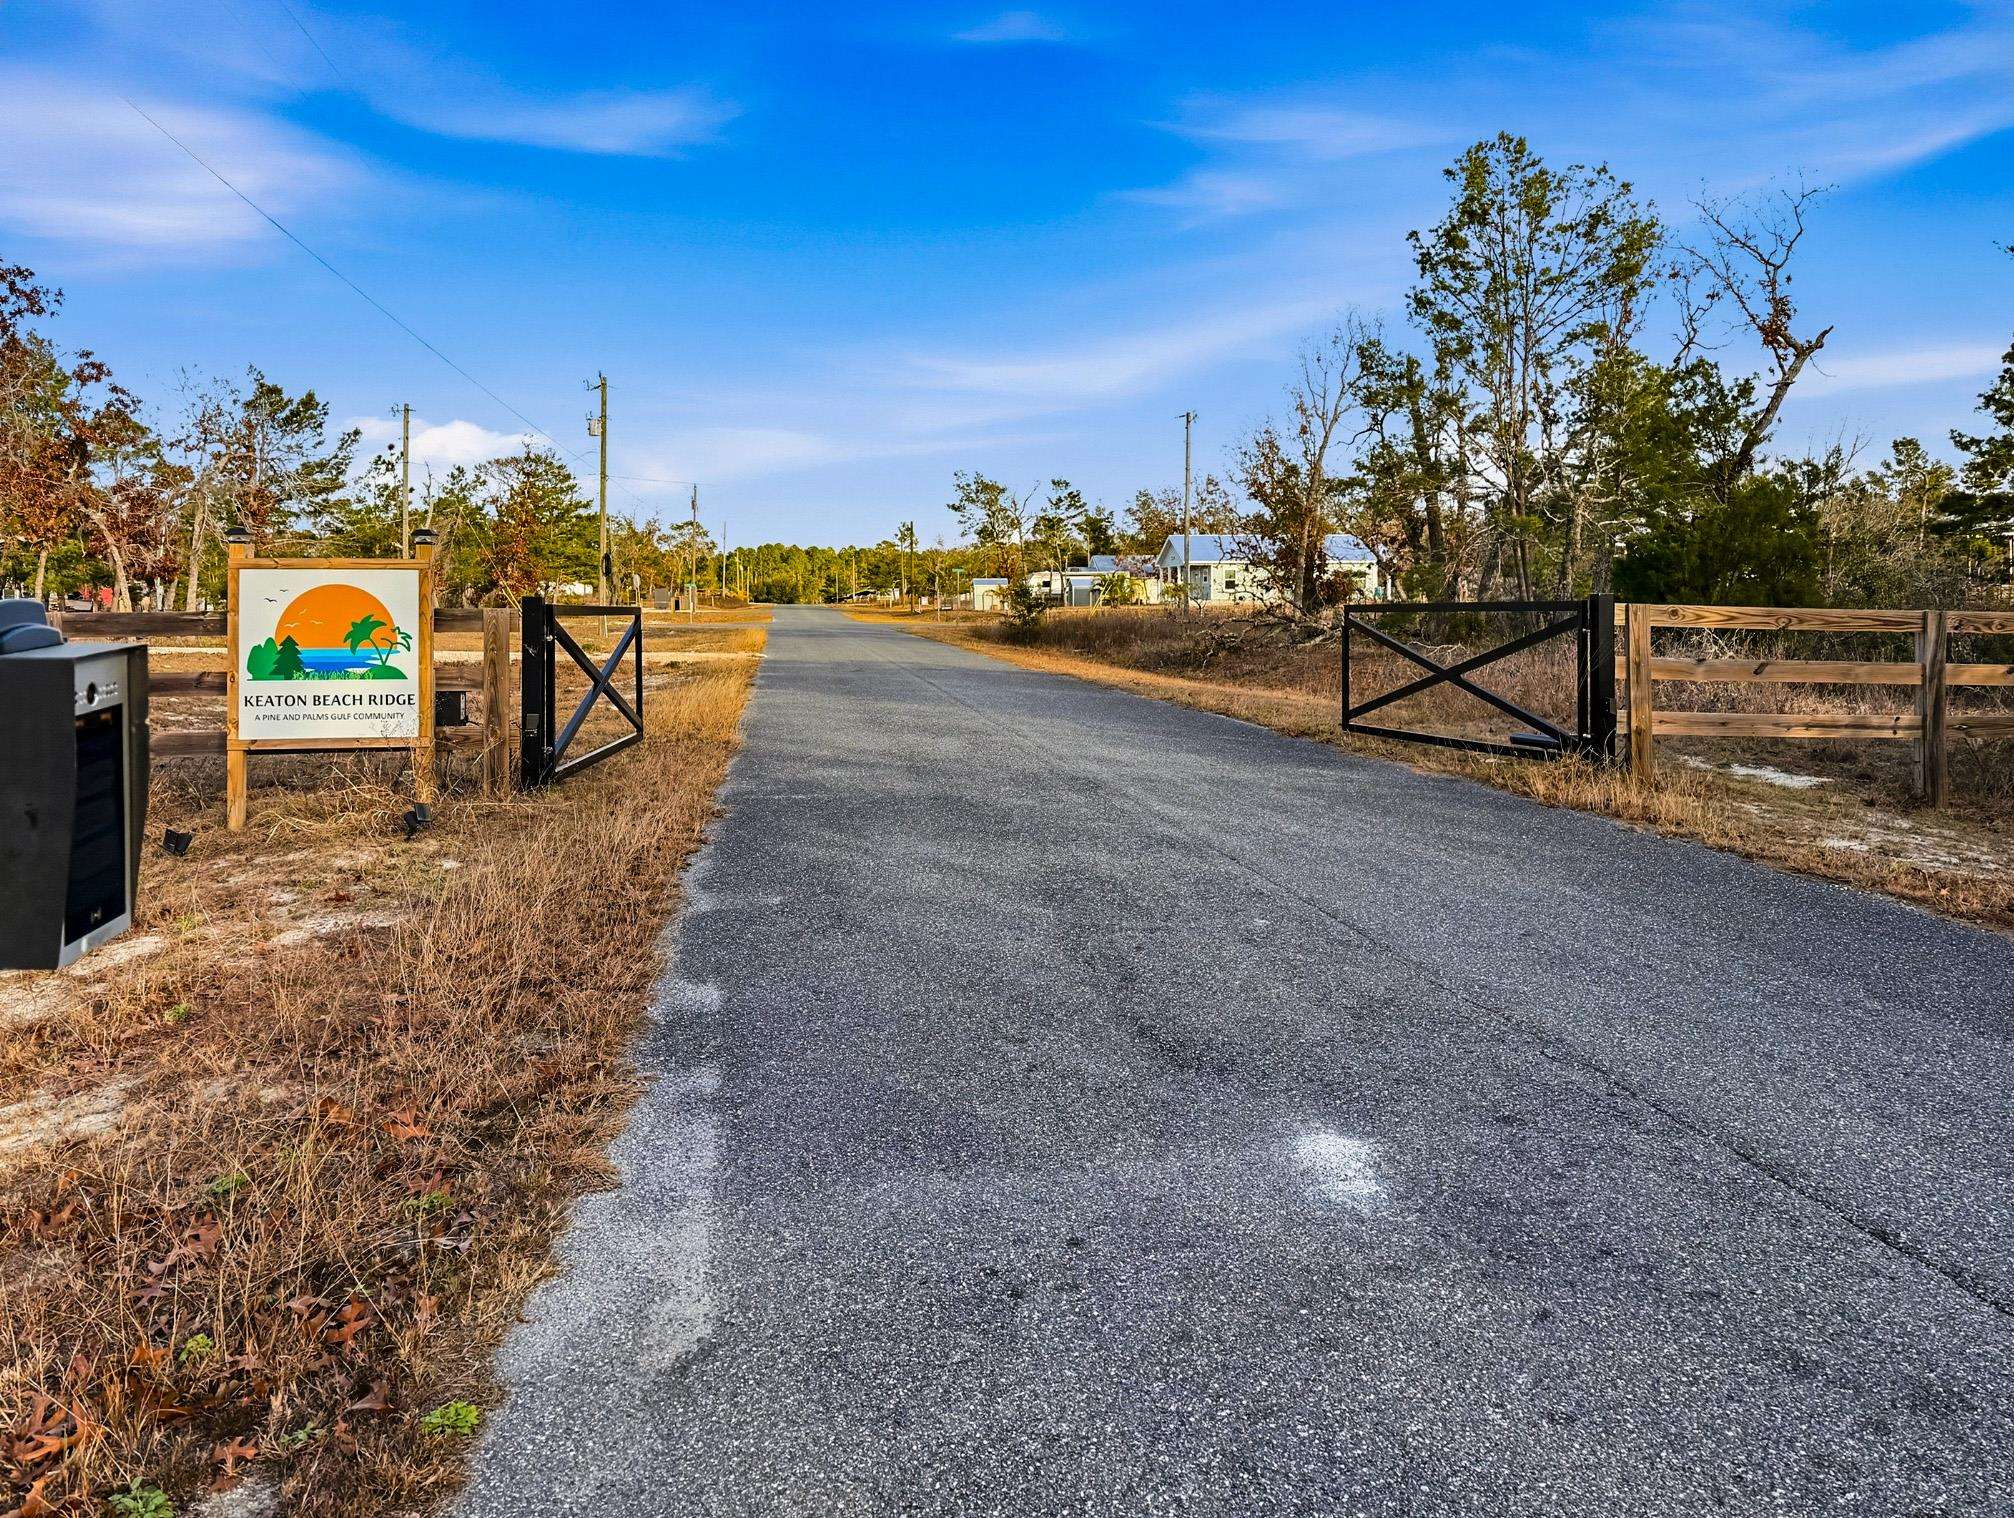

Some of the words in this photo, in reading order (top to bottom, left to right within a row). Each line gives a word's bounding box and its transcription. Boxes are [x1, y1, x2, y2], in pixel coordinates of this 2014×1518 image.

[244, 695, 307, 707] KEATON
[312, 694, 363, 706] BEACH
[368, 693, 416, 706] RIDGE
[254, 713, 261, 721] A
[262, 713, 281, 721] PINE
[282, 713, 301, 721] AND
[302, 713, 330, 721] PALMS
[330, 713, 352, 721] GULF
[352, 712, 405, 721] COMMUNITY
